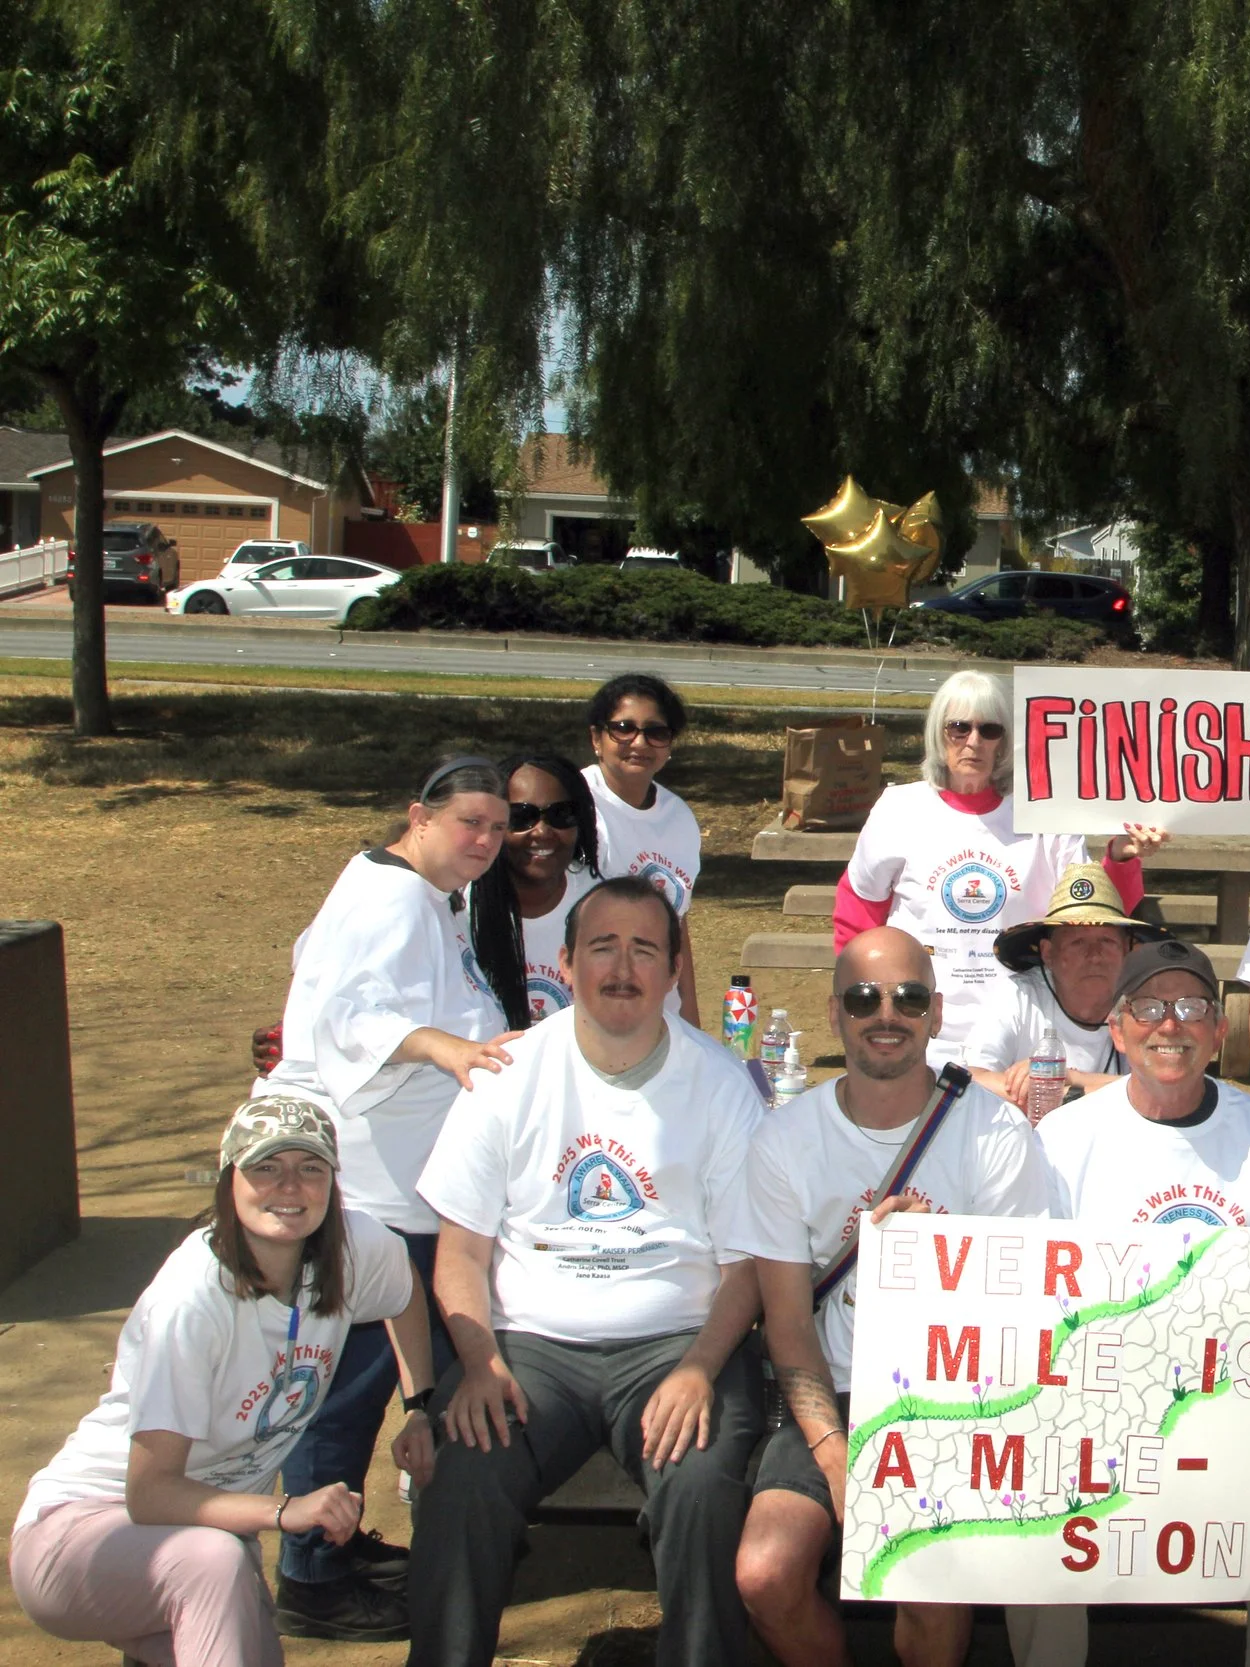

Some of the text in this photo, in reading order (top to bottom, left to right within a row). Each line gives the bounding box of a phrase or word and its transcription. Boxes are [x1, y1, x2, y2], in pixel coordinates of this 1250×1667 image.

[652, 852, 672, 868] This
[675, 867, 692, 890] Way
[927, 849, 1021, 892] 2025 Walk This Way
[278, 1102, 303, 1128] B
[552, 1147, 577, 1184] 2025
[608, 1139, 636, 1167] This
[635, 1167, 659, 1200] Way
[841, 1205, 864, 1242] 2025
[1146, 1184, 1187, 1209] Walk
[1193, 1185, 1226, 1208] This
[1228, 1203, 1247, 1226] Wa
[878, 1230, 1142, 1302] EVERY
[926, 1325, 1123, 1393] MILE
[236, 1381, 269, 1422] 2025
[872, 1431, 916, 1489] A
